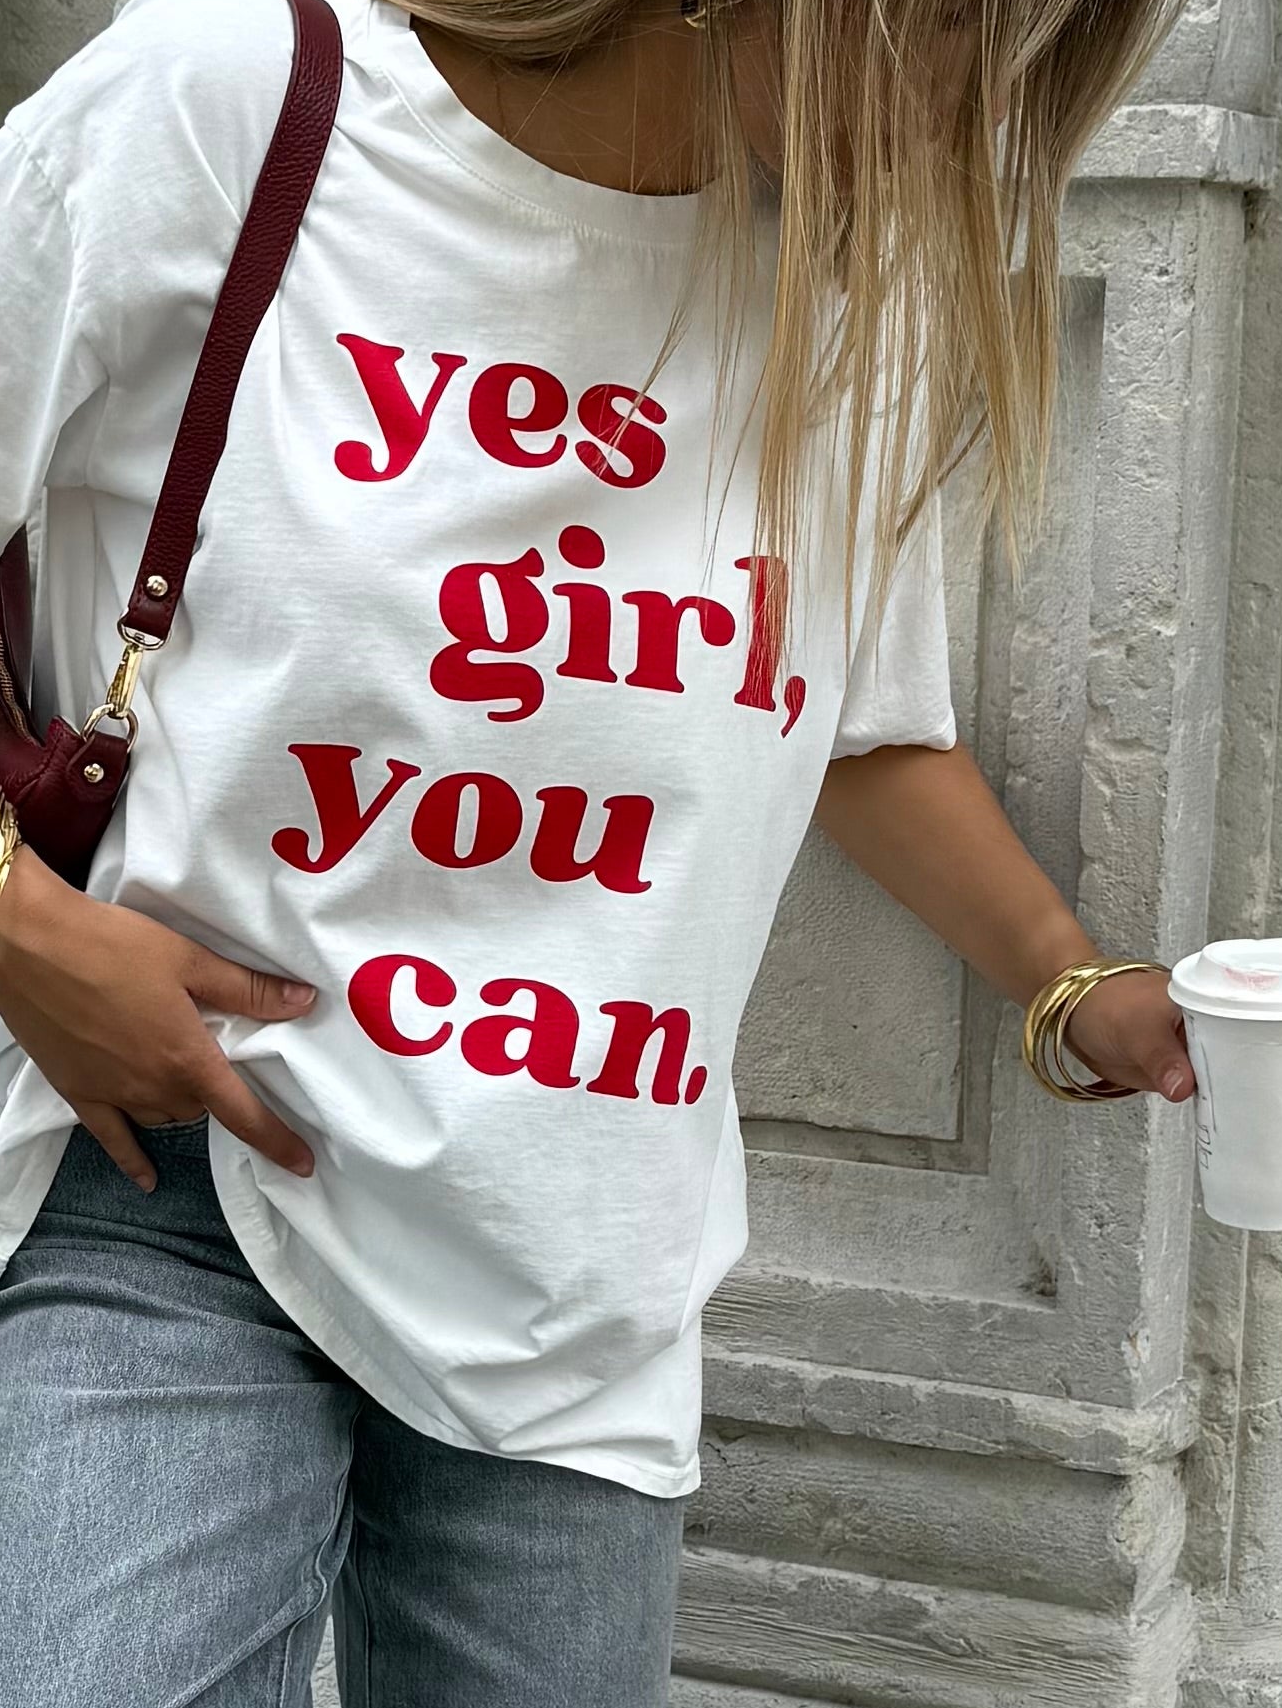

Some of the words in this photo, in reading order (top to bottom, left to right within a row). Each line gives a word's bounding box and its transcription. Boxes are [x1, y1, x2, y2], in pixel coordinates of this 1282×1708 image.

[333, 333, 667, 489] yes
[429, 525, 807, 738] girl,
[271, 743, 654, 895] you
[348, 953, 708, 1106] can.
